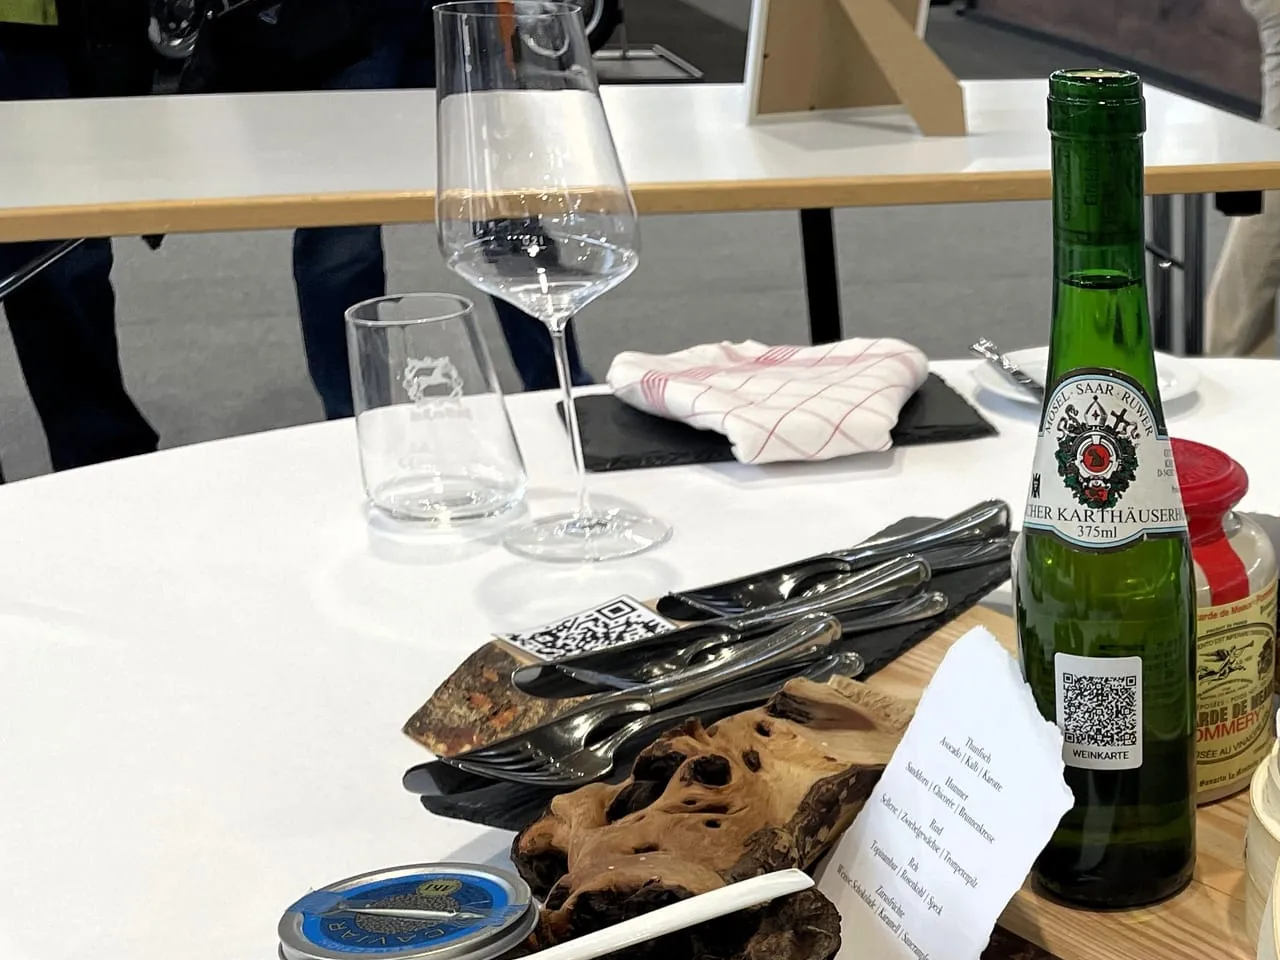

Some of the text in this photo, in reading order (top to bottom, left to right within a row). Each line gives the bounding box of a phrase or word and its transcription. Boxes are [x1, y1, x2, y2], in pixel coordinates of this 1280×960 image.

[1044, 382, 1154, 436] MOSEL SAAR RUWER
[1077, 525, 1117, 538] 375ml
[1232, 699, 1248, 719] DE
[940, 736, 961, 759] Avocado
[982, 769, 1003, 792] Karotte
[1072, 749, 1130, 760] WEINKARTE
[328, 921, 444, 945] CAVIAR
